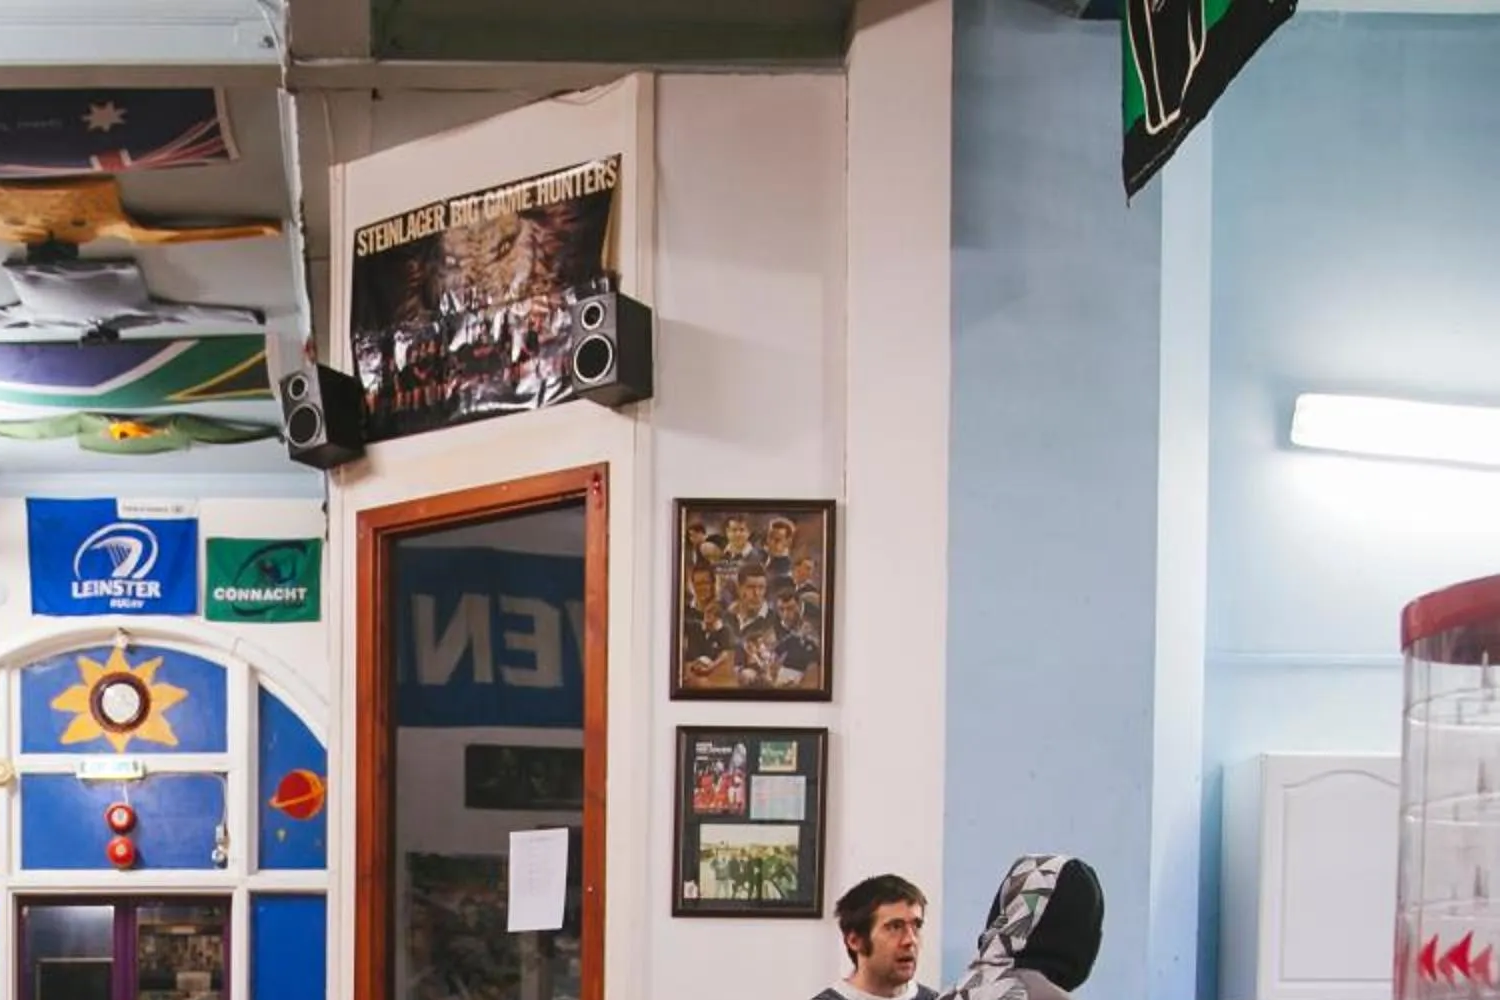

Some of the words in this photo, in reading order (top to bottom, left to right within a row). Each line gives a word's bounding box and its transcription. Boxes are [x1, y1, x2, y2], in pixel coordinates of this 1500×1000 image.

[357, 203, 446, 257] STEINLAGER
[450, 196, 480, 228] BIG
[483, 182, 533, 220] GAME
[536, 159, 618, 207] HUNTERS
[71, 579, 162, 599] LEINSTER
[213, 586, 308, 602] CONNACHT
